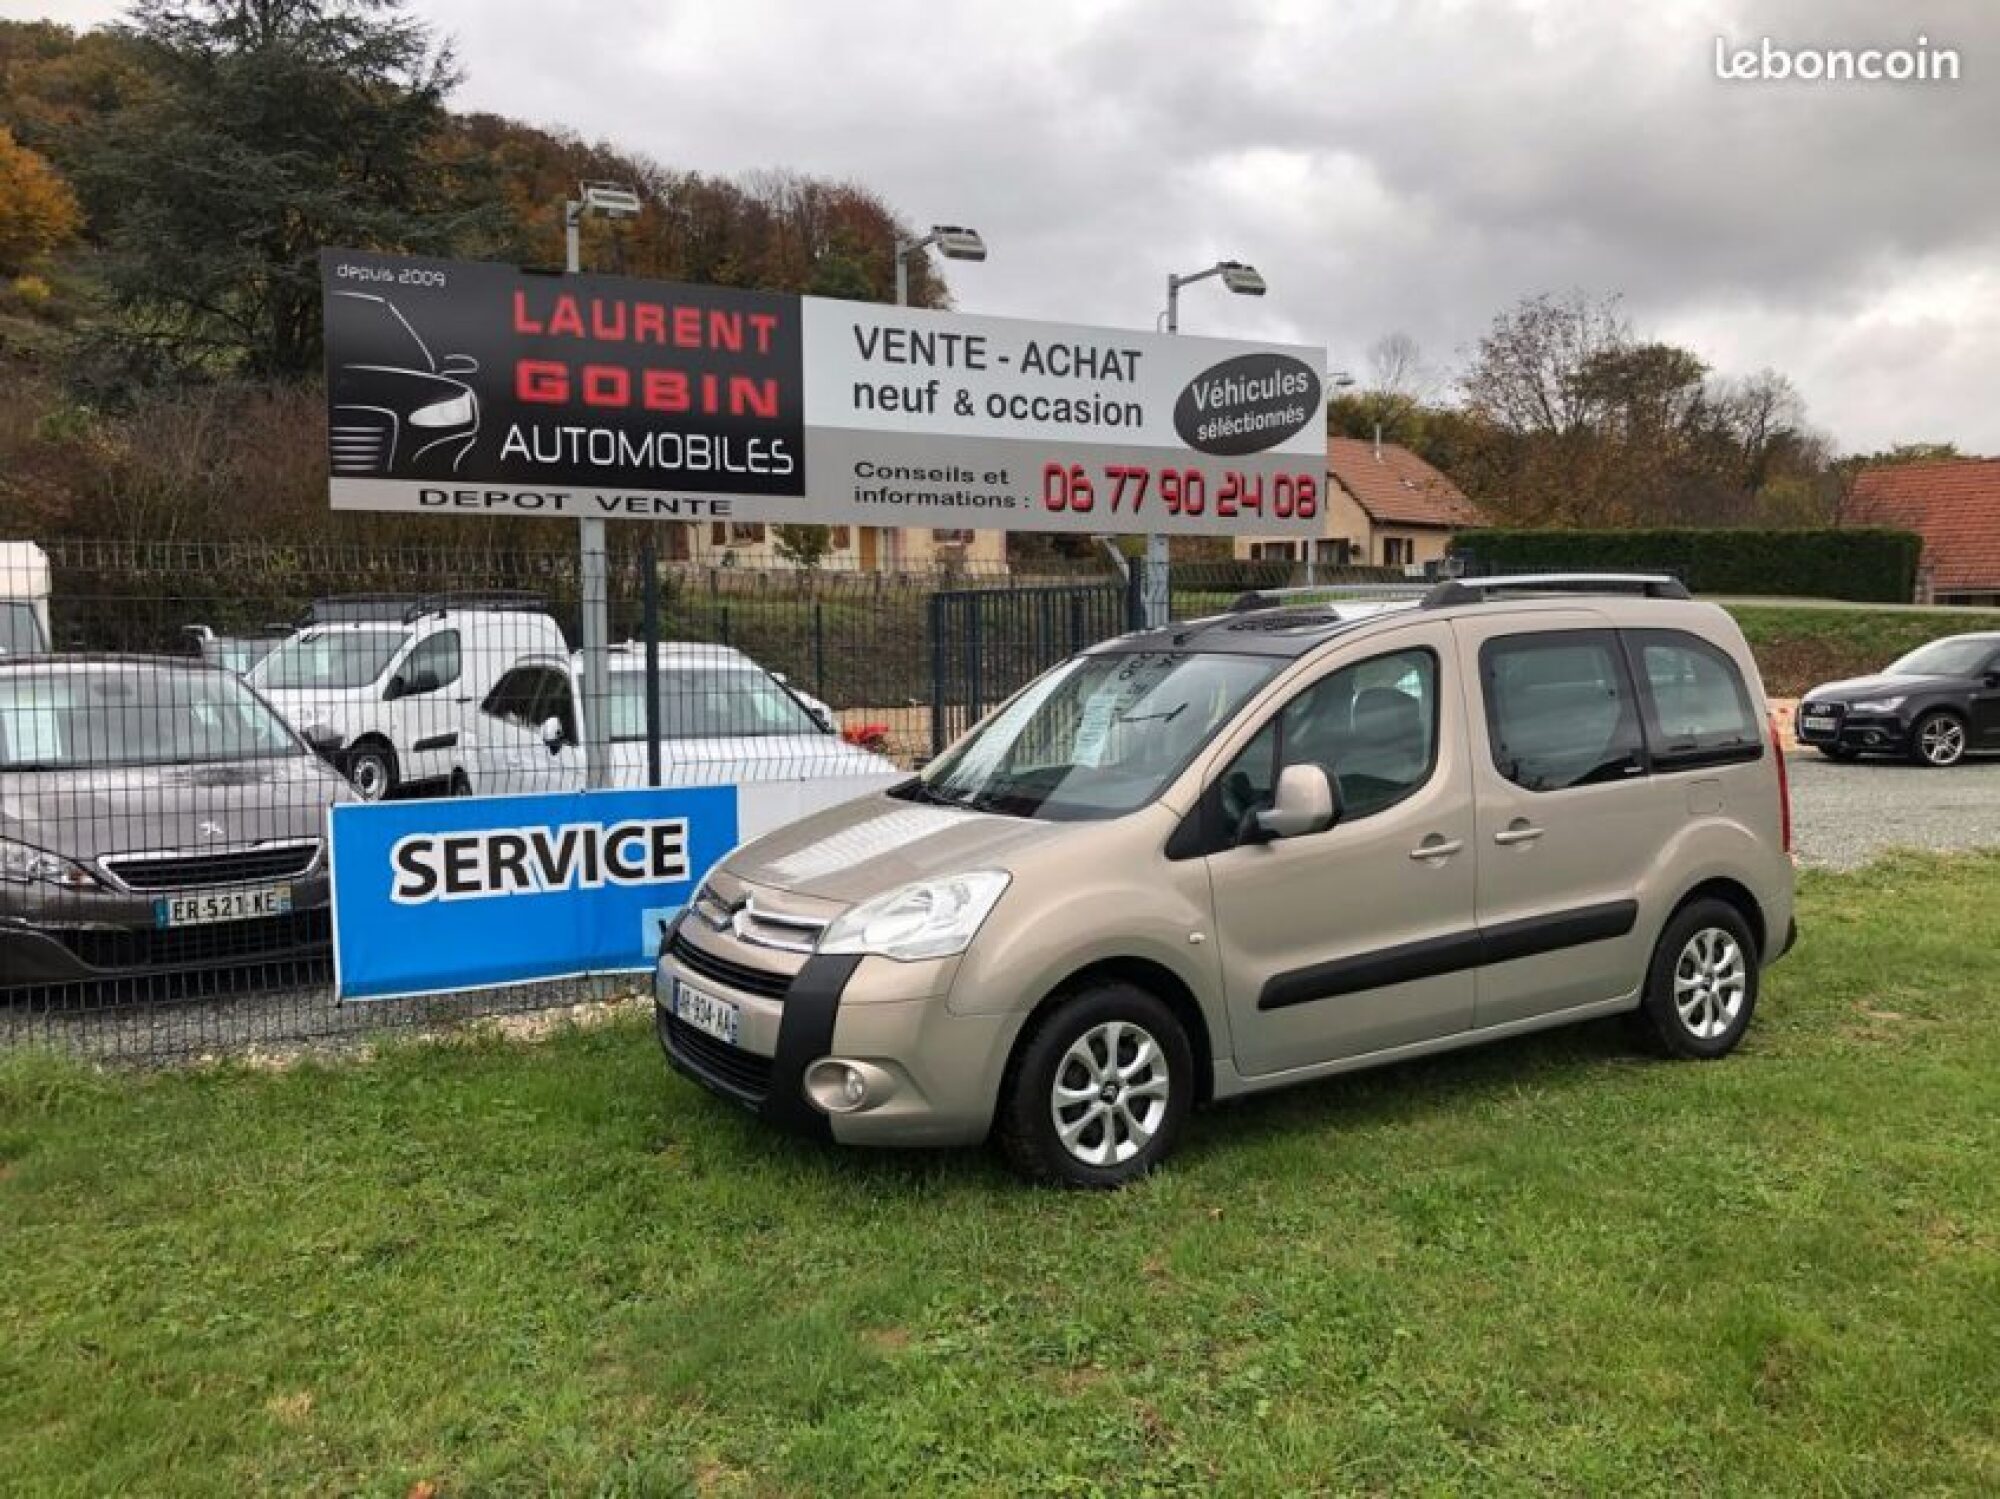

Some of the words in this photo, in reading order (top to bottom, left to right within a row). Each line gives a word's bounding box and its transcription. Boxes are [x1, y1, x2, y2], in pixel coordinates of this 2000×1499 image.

[337, 264, 394, 282] depuis
[398, 268, 445, 287] 2009
[513, 289, 777, 354] LAURENT
[853, 324, 987, 371] VENTE
[1020, 340, 1143, 383] ACHAT
[514, 358, 779, 418] GOBIN
[853, 380, 940, 415] neuf
[953, 392, 975, 418] &
[985, 394, 1143, 428] occasion
[1191, 368, 1309, 411] Véhicules
[499, 422, 794, 475] AUTOMOBILES
[853, 461, 975, 484] Conseils
[983, 468, 1010, 485] et
[418, 488, 571, 511] DEPOT
[595, 494, 733, 517] VENTE
[853, 486, 1016, 509] informations
[1042, 461, 1094, 513] 06
[1104, 464, 1150, 515] 77
[1158, 467, 1205, 516] 90
[1216, 470, 1264, 518] 24
[1272, 473, 1317, 519] 08
[397, 822, 686, 899] SERVICE
